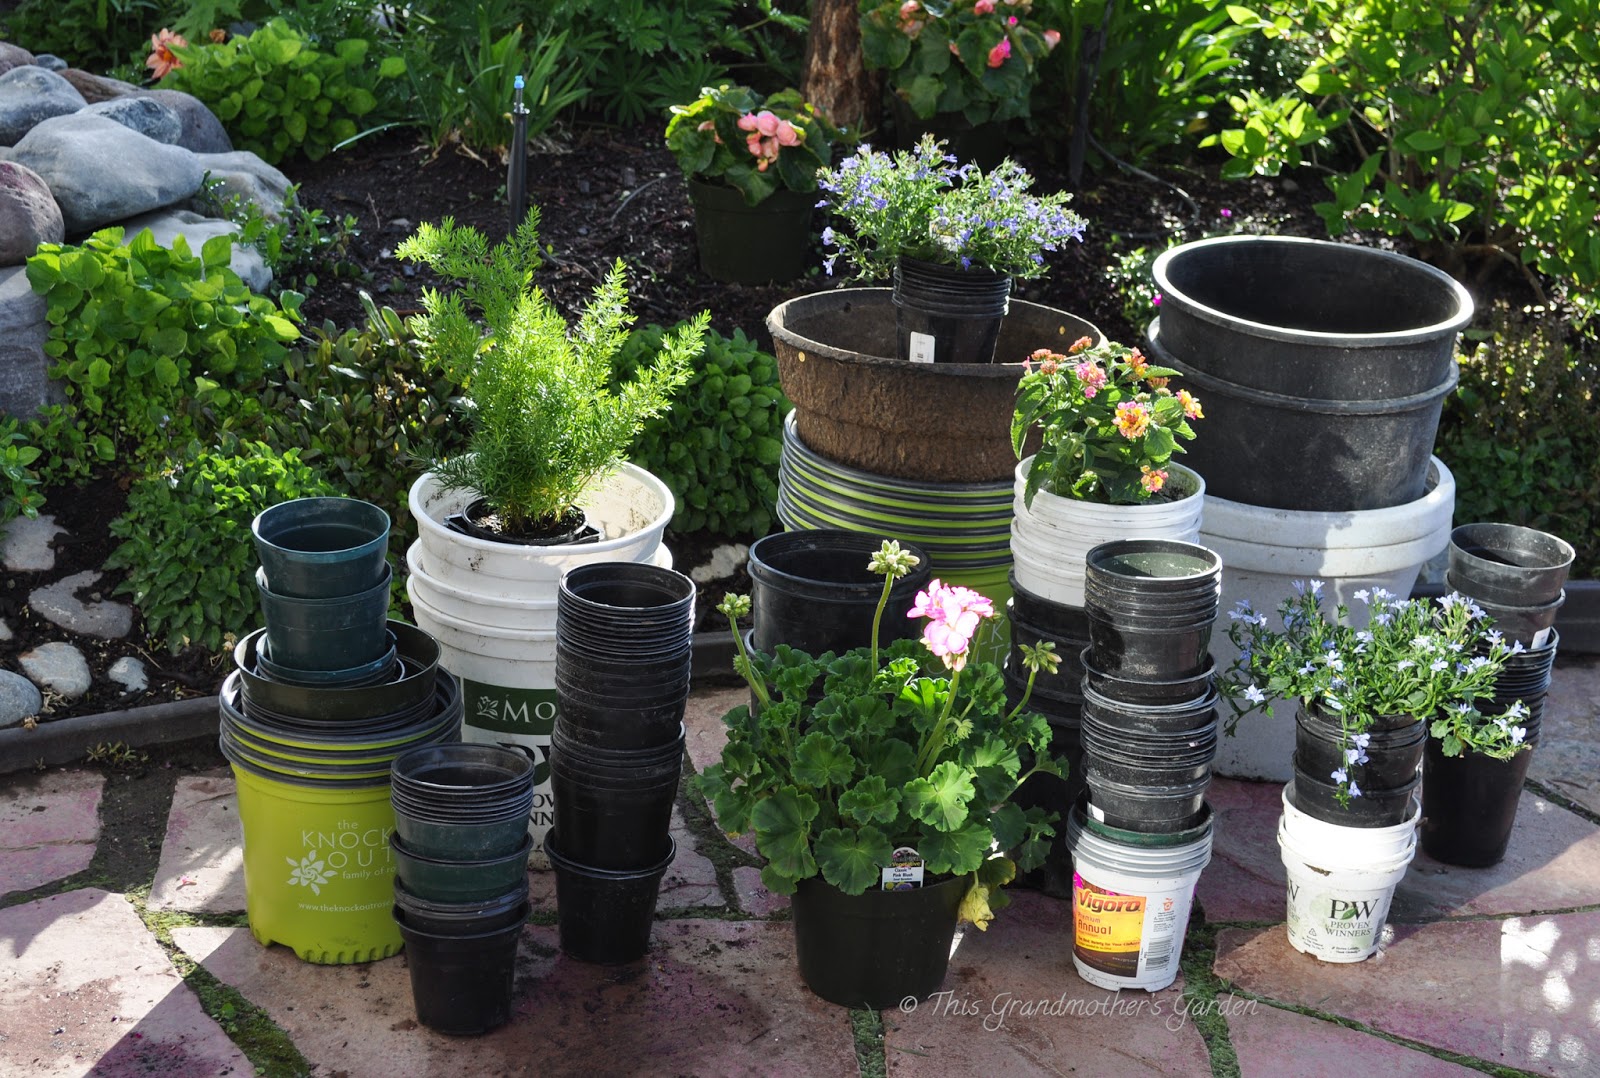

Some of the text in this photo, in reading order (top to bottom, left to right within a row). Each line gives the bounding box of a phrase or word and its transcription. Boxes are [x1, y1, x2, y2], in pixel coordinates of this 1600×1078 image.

[502, 700, 557, 723] MO
[338, 820, 358, 830] the
[302, 826, 393, 850] KNOCK
[328, 846, 391, 869] OUT
[342, 869, 371, 881] family
[374, 867, 385, 876] of
[1079, 889, 1141, 913] Vigoro
[1328, 898, 1380, 921] PW
[1078, 911, 1101, 924] Premium
[1330, 920, 1371, 930] PROVEN
[1078, 919, 1112, 936] Annual
[1325, 927, 1373, 938] WINNERS
